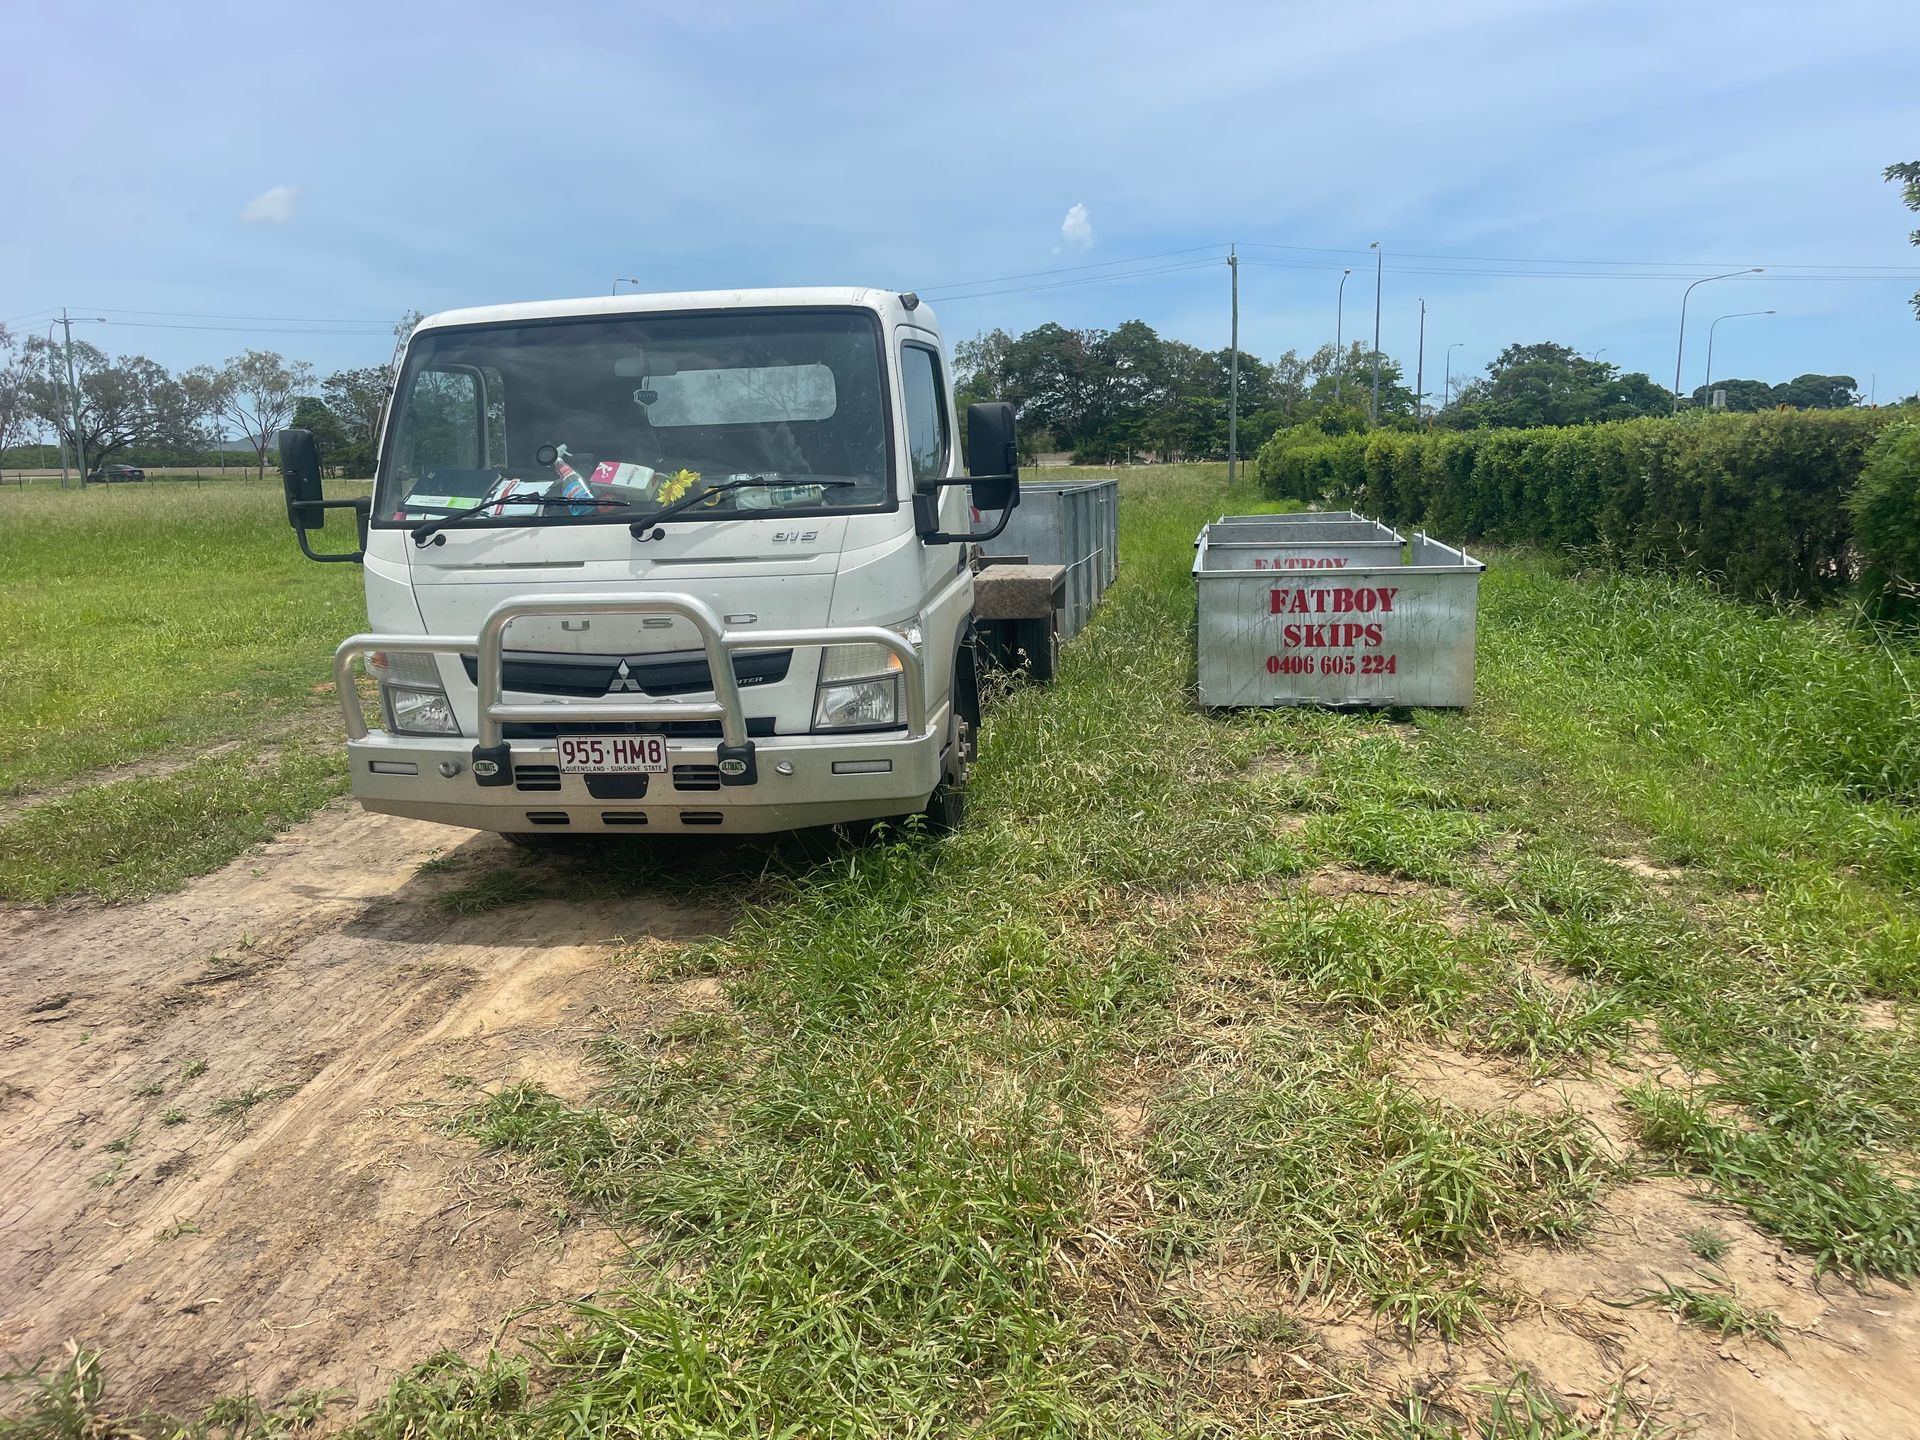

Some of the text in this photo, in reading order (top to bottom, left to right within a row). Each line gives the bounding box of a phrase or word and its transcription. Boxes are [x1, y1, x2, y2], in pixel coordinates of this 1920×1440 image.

[771, 530, 819, 544] 915
[1254, 558, 1349, 570] FATBOY
[1270, 587, 1399, 614] FATBOY
[505, 613, 758, 632] USO
[1283, 623, 1384, 648] SKIPS
[1266, 654, 1398, 674] 0406 605 224
